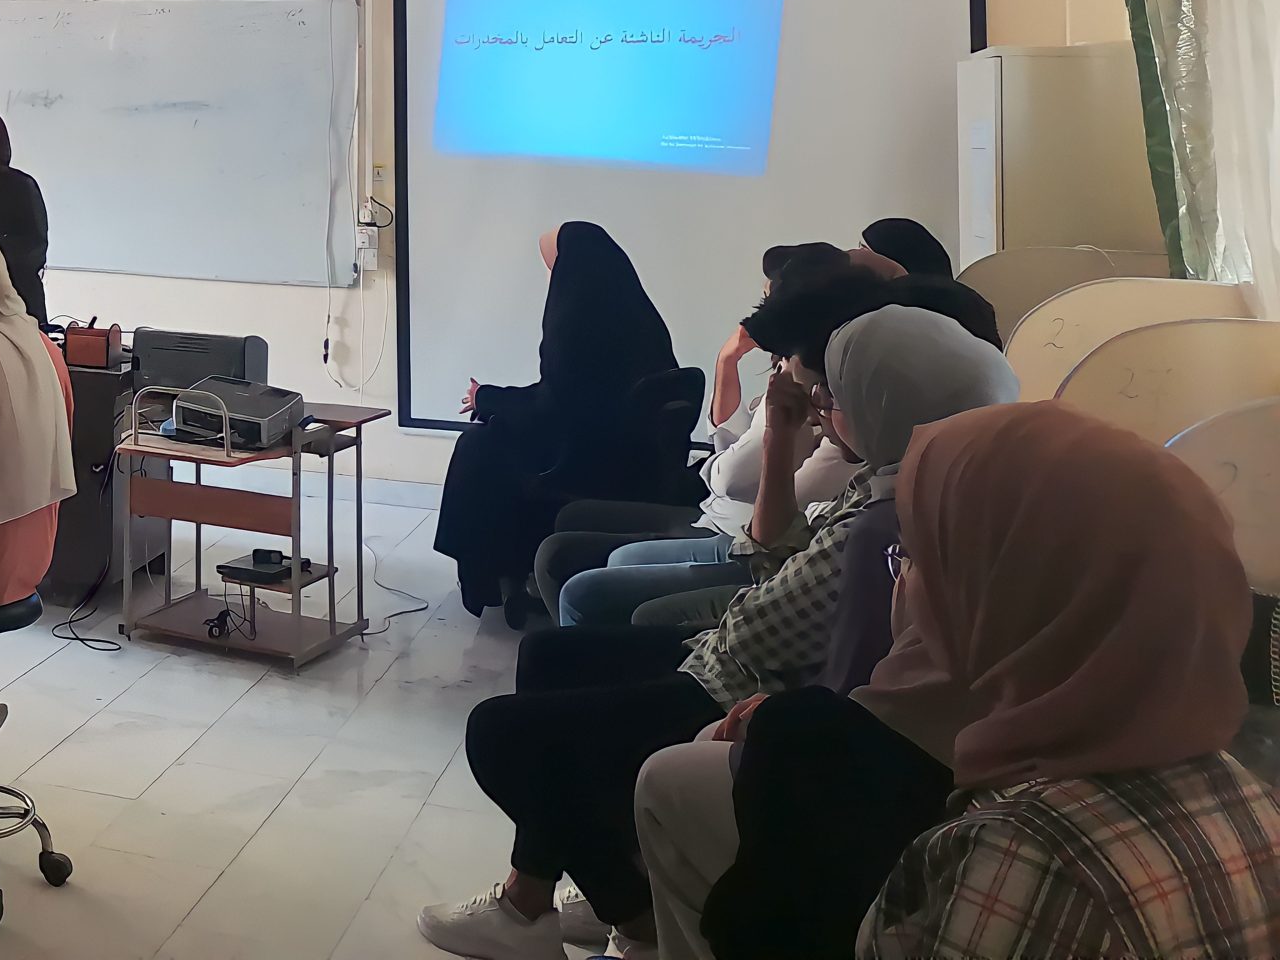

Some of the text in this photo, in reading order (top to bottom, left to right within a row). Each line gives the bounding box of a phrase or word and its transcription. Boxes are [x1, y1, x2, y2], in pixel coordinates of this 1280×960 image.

[454, 30, 528, 50] بالمخدرات
[534, 29, 583, 51] التعامل
[590, 33, 614, 50] عن
[621, 28, 671, 44] الناشئة
